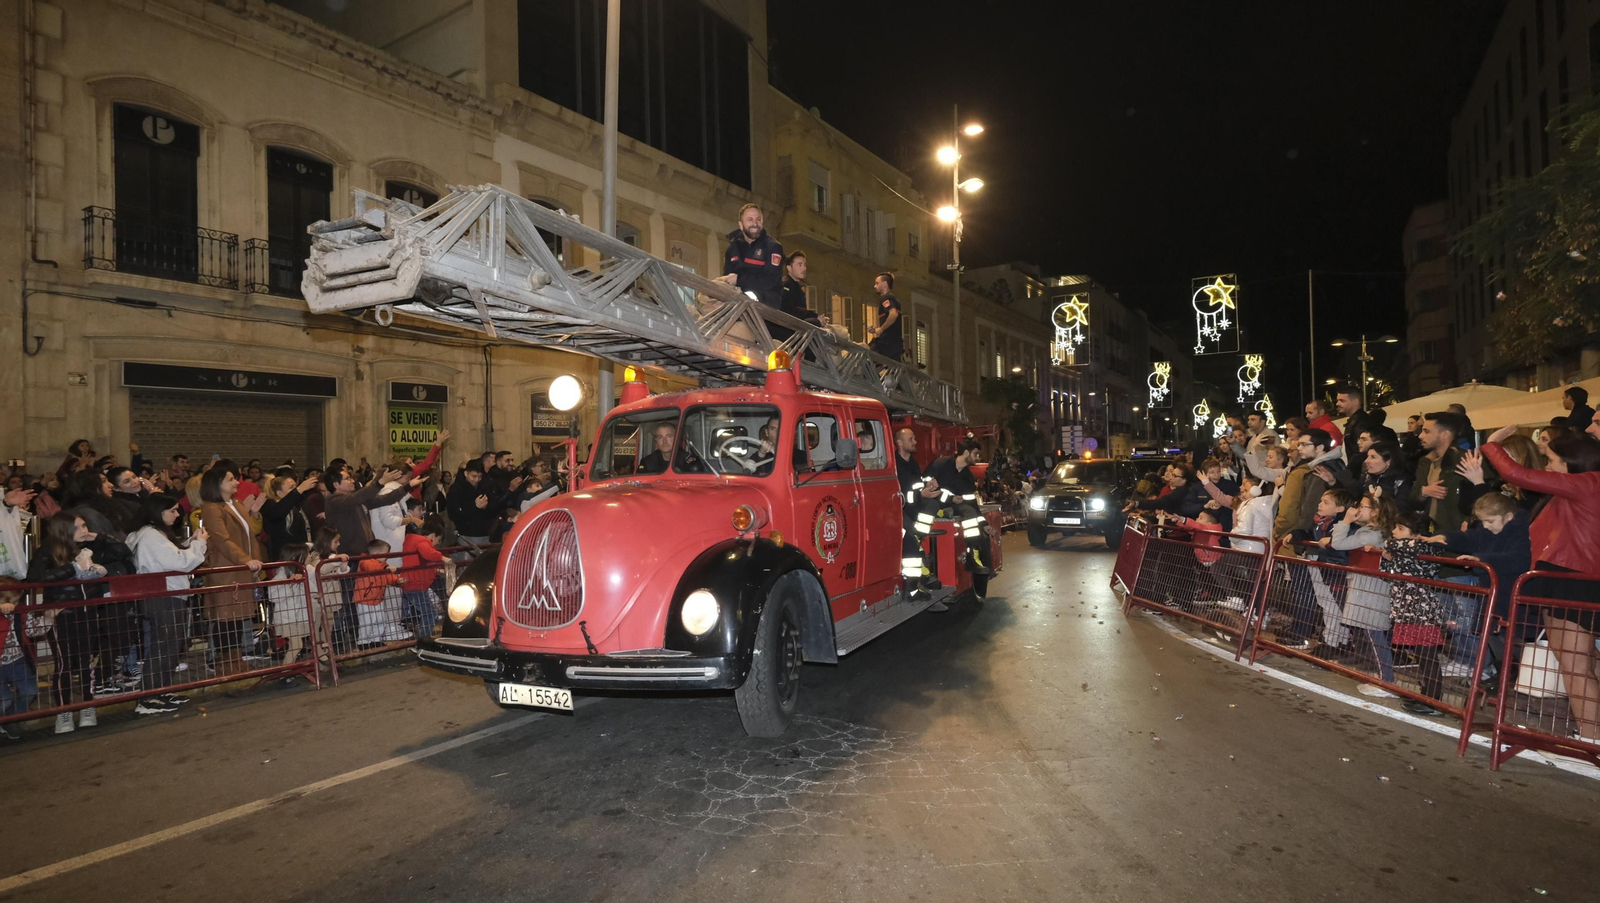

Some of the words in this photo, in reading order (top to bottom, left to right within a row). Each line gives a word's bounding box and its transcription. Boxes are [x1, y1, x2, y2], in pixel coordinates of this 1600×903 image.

[390, 411, 403, 425] SE
[406, 411, 438, 425] VENDE
[391, 429, 397, 443] O
[400, 429, 438, 443] ALQUILA
[392, 446, 416, 454] Superficie
